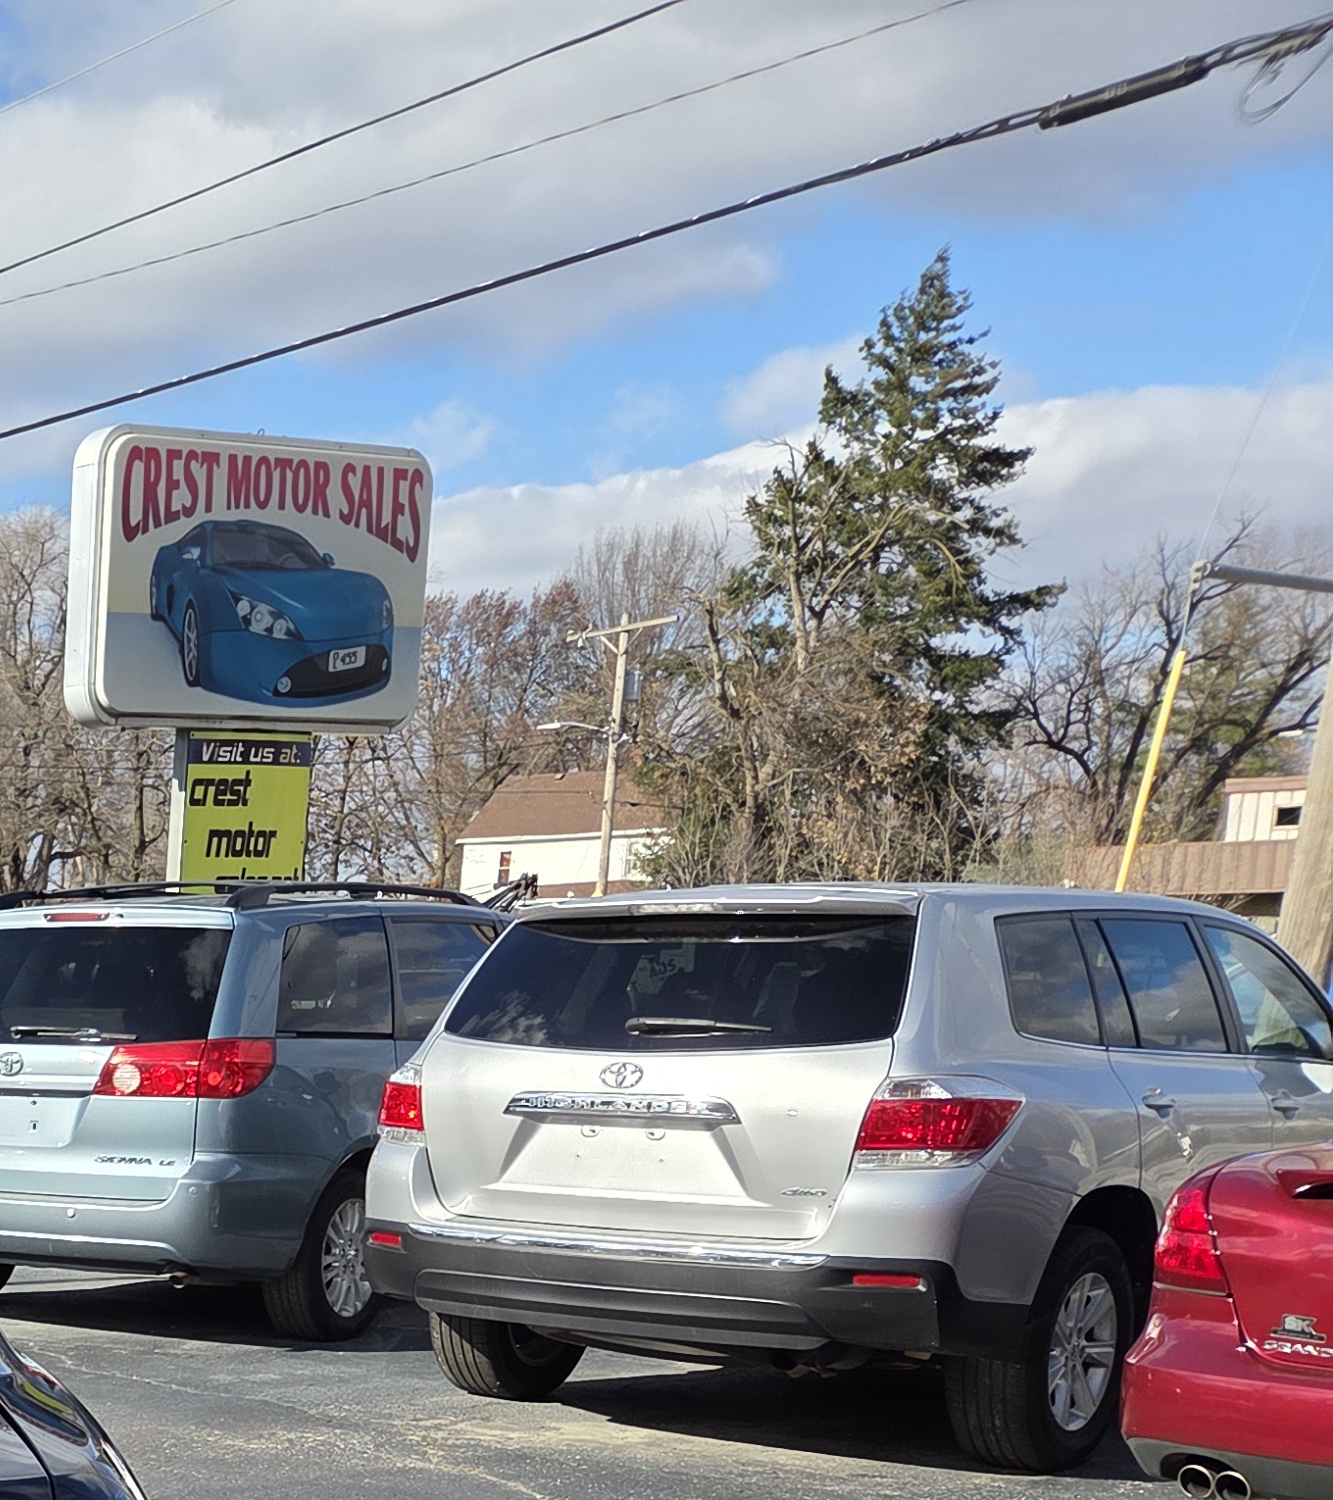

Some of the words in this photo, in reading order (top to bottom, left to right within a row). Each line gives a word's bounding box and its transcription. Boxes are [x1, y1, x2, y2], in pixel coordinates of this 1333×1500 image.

[121, 445, 221, 543] CREST
[226, 453, 331, 519] MOTOR
[339, 462, 424, 563] SALES
[201, 742, 245, 763] Visit
[249, 747, 276, 763] us
[279, 744, 302, 764] at:
[189, 769, 253, 807] crest
[205, 821, 278, 859] motor
